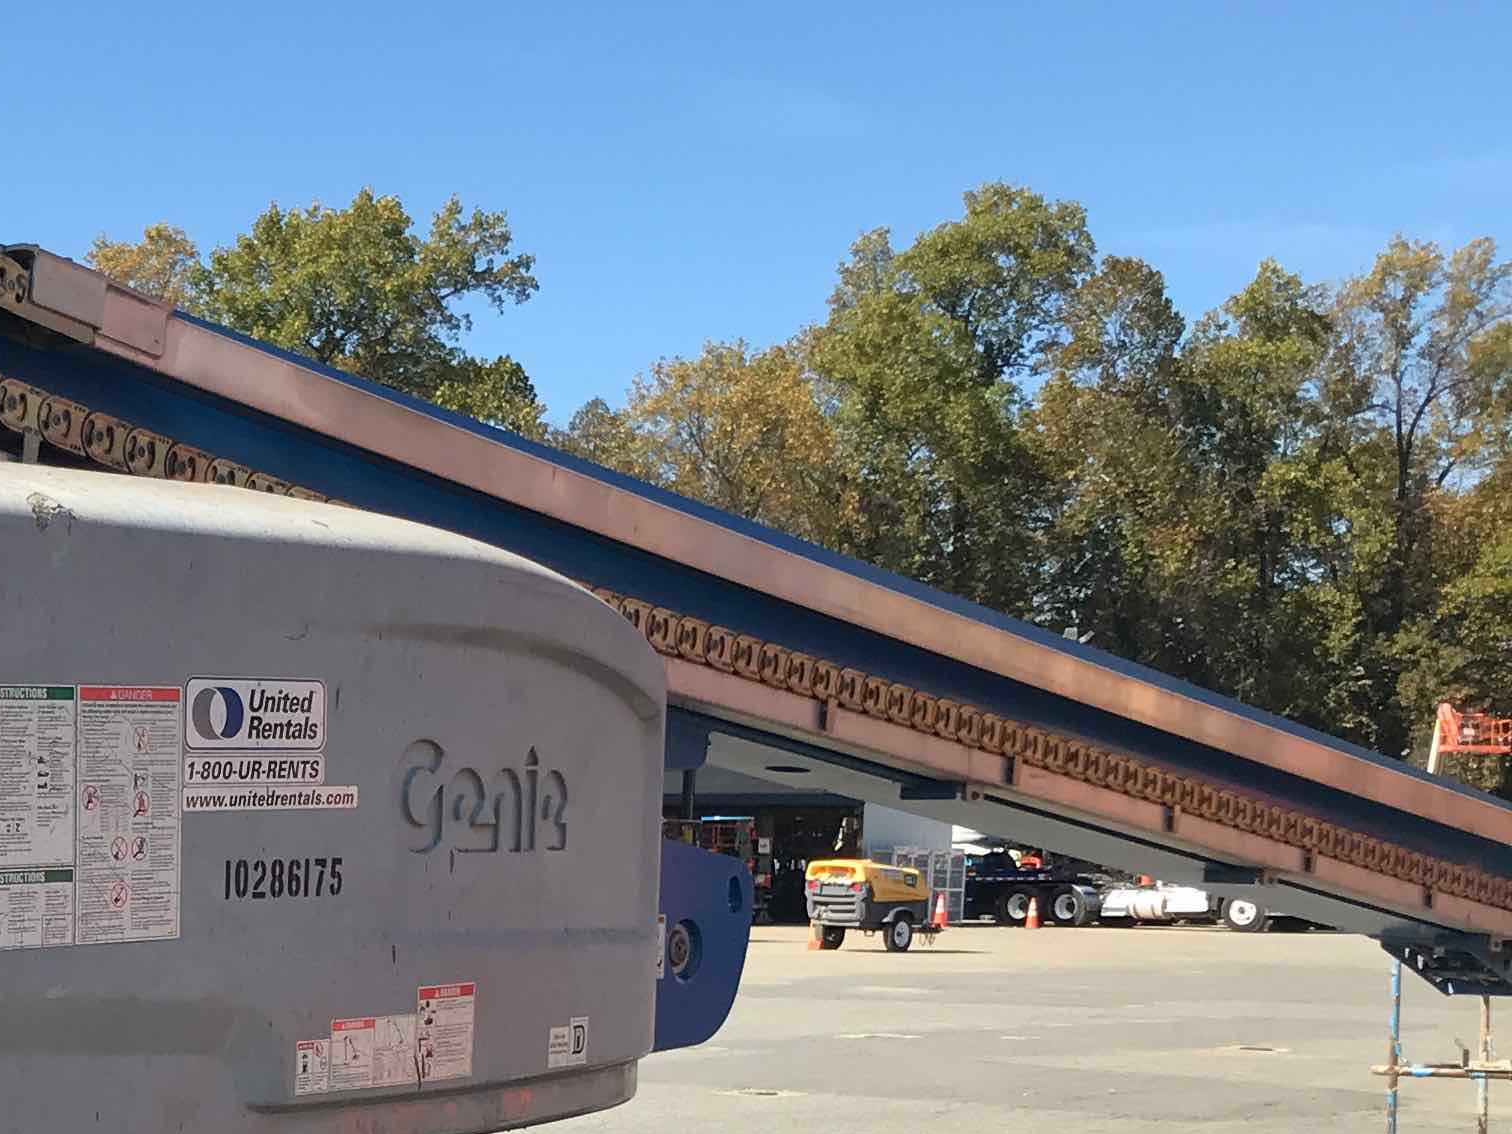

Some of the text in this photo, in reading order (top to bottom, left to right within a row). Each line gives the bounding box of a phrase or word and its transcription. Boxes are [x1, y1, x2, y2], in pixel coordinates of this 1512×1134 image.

[249, 689, 314, 713] United
[247, 716, 318, 740] Rentals
[187, 760, 319, 780] 1-800-UR-RENTS
[186, 789, 354, 809] www.unitedrentals.com
[225, 856, 343, 900] 10286175
